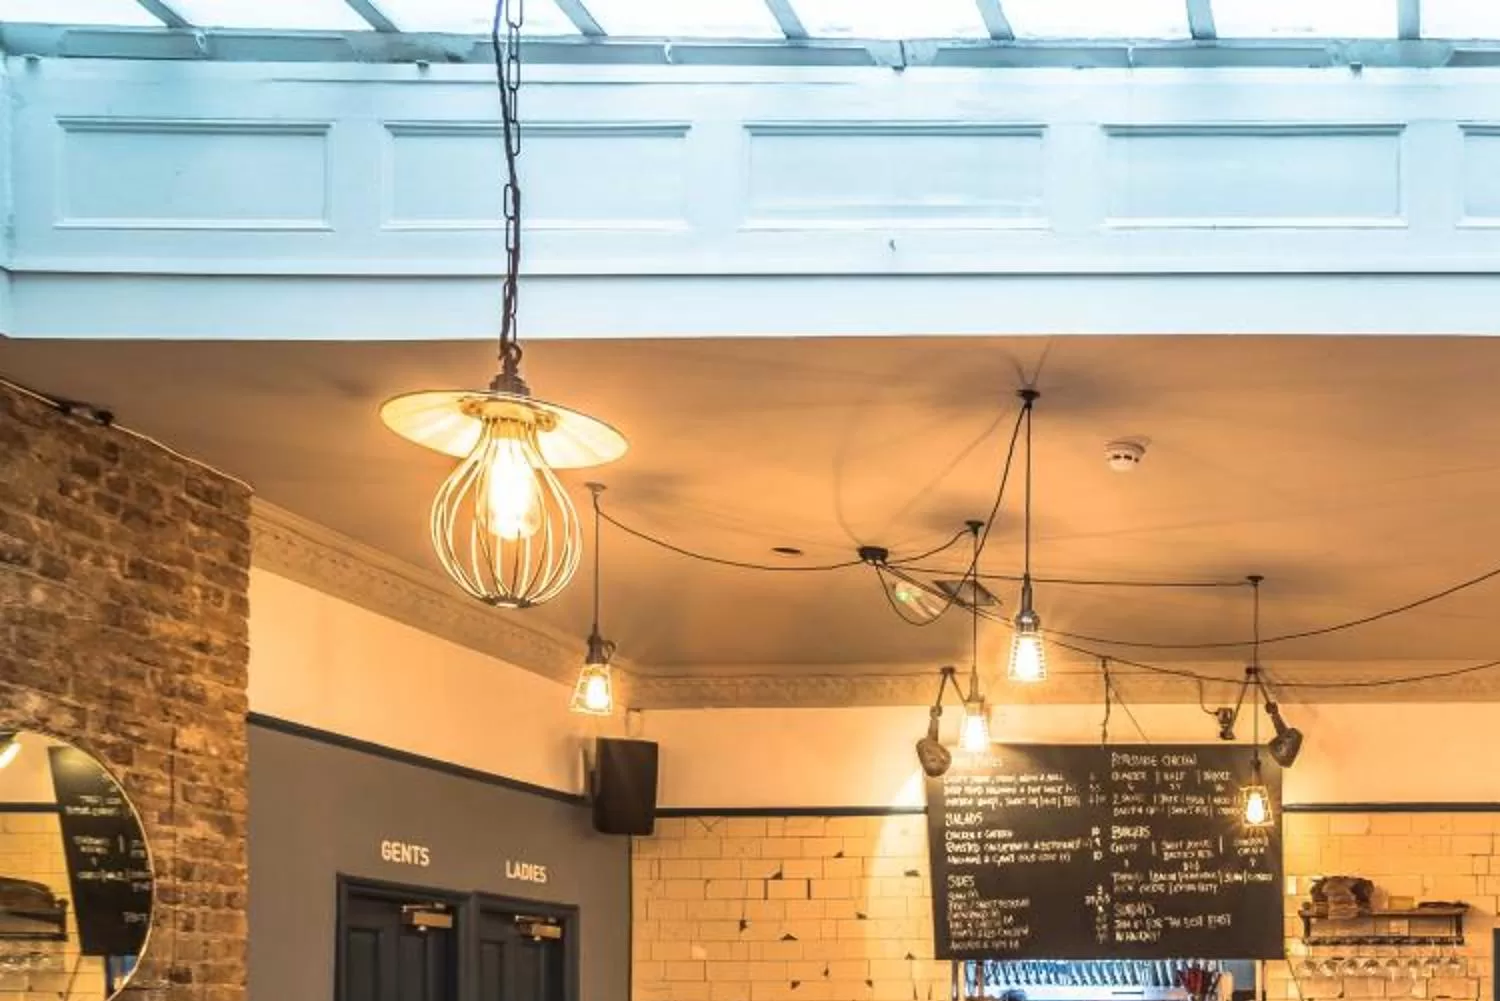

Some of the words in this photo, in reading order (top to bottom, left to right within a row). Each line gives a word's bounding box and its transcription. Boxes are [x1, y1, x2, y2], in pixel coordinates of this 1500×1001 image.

[381, 839, 431, 867] GENTS
[505, 859, 548, 884] LADIES
[947, 875, 975, 889] SIDES
